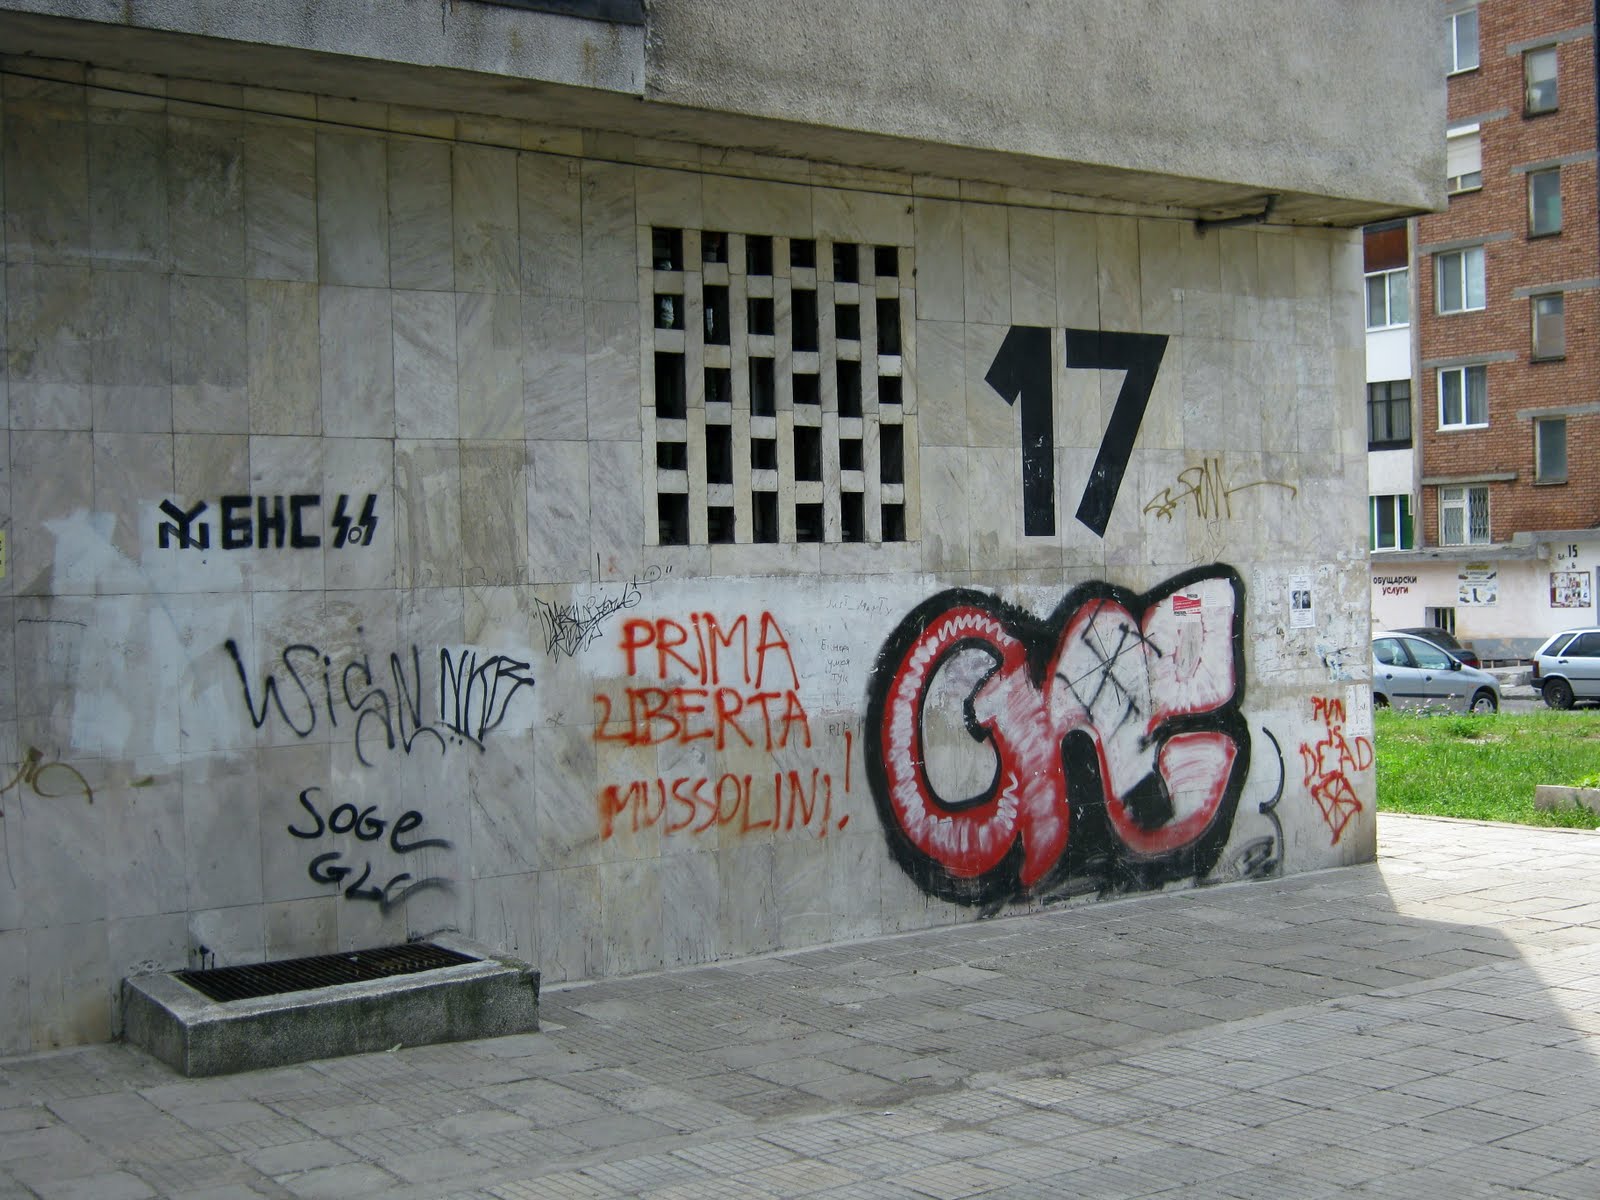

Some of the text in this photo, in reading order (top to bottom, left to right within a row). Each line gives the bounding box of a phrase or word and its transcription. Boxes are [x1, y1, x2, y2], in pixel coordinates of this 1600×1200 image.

[984, 325, 1169, 538] 17
[1568, 544, 1578, 558] 15
[1372, 575, 1418, 586] ОБУЩАРСКИ
[1382, 586, 1409, 596] УСЛУГИ
[618, 611, 800, 690] PRIMA
[1299, 735, 1373, 787] DEAD
